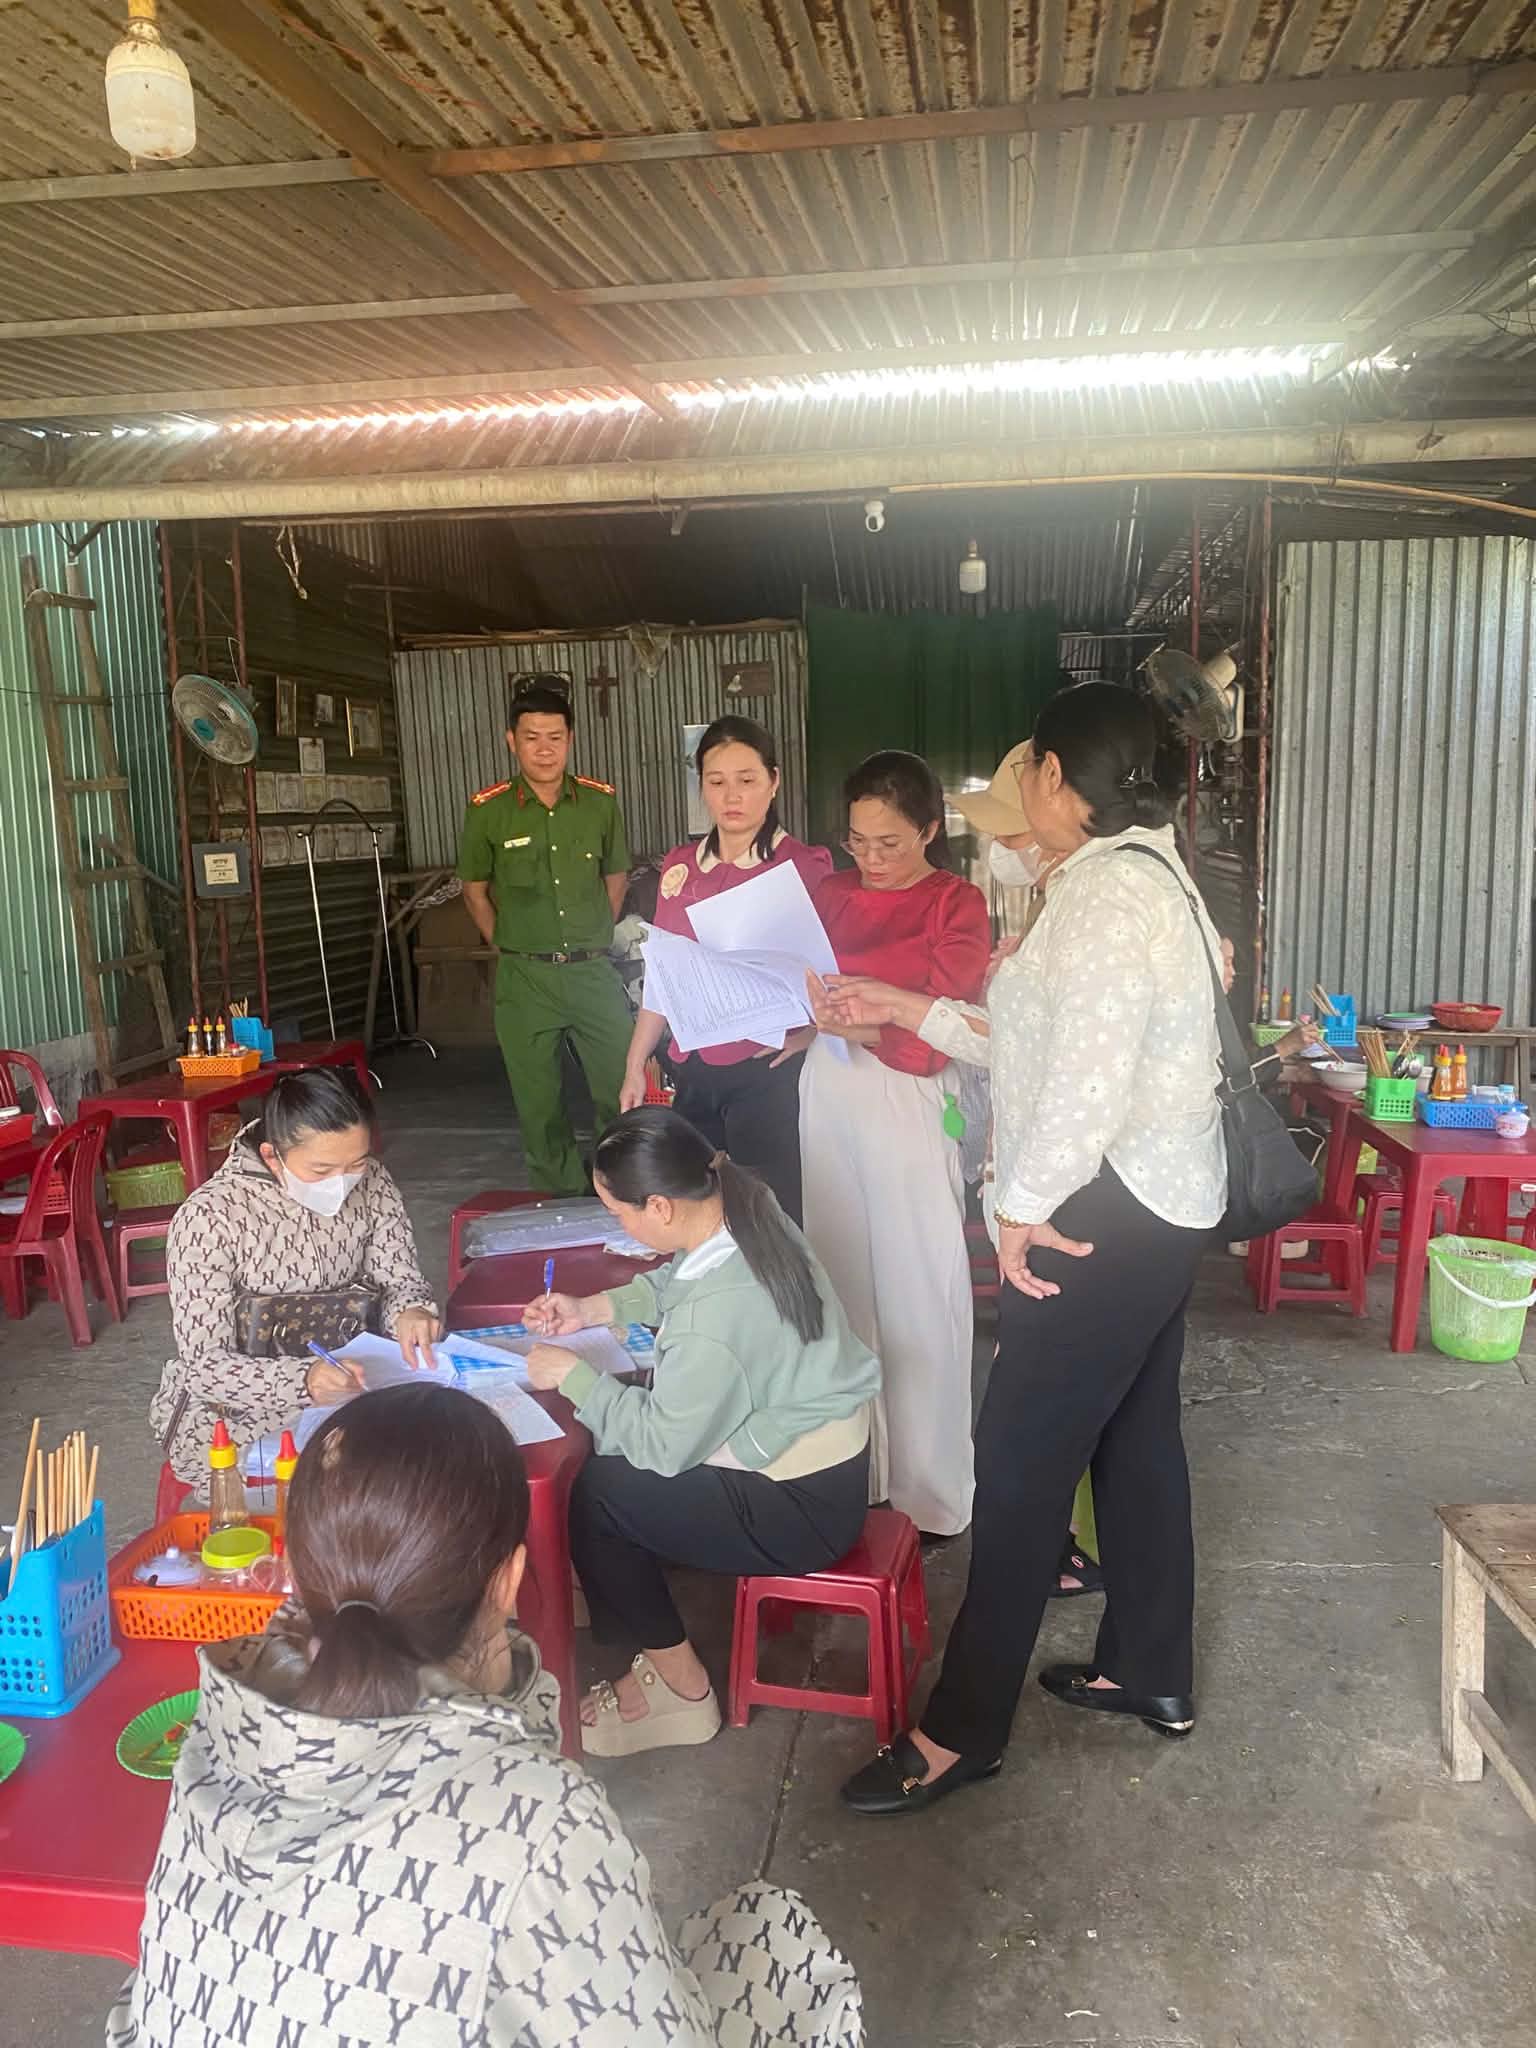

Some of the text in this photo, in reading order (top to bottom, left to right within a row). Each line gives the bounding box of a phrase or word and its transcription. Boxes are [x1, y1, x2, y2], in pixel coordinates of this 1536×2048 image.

[190, 1232, 203, 1246] N
[203, 1248, 212, 1262] Y
[274, 1251, 284, 1266] Y
[284, 1234, 294, 1249] N
[295, 1244, 304, 1258] Y
[203, 1273, 212, 1288] Y
[253, 1258, 262, 1272] Y
[263, 1270, 273, 1285] N
[287, 1262, 300, 1278] N
[302, 1272, 312, 1286] Y
[192, 1314, 203, 1329] N
[205, 1297, 215, 1310] Y
[206, 1323, 217, 1339] Y
[294, 1736, 336, 1764] N
[419, 1737, 462, 1765] Y
[489, 1756, 523, 1787] Y
[374, 1768, 418, 1802] N
[426, 1778, 475, 1820] N
[387, 1804, 421, 1851] Y
[495, 1793, 543, 1839] N
[585, 1806, 615, 1846] Y
[330, 1842, 374, 1888] N
[453, 1822, 490, 1867] Y
[174, 1870, 206, 1916] N
[390, 1856, 438, 1905] N
[536, 1850, 571, 1896] Y
[582, 1857, 618, 1914] N
[211, 1889, 245, 1938] N
[298, 1874, 327, 1920] Y
[352, 1890, 386, 1938] Y
[458, 1874, 506, 1925] N
[732, 1892, 764, 1914] N
[156, 1898, 171, 1944] Y
[189, 1918, 208, 1965] Y
[252, 1909, 288, 1958] N
[417, 1907, 453, 1956] Y
[527, 1909, 571, 1963] N
[575, 1919, 607, 1966] Y
[750, 1918, 771, 1954] Y
[782, 1904, 807, 1941] N
[227, 1939, 249, 1987] Y
[298, 1926, 339, 1976] N
[355, 1943, 403, 1995] N
[618, 1925, 650, 1981] N
[713, 1942, 746, 1975] N
[794, 1947, 816, 1985] Y
[158, 1950, 181, 2000] N
[267, 1960, 294, 2008] Y
[424, 1962, 472, 2015] N
[515, 1968, 551, 2011] Y
[764, 1957, 790, 2000] N
[806, 1982, 836, 2011] N
[189, 1972, 219, 2024] N
[224, 1994, 258, 2047] N
[320, 1978, 351, 2028] Y
[564, 1978, 607, 2031] N
[611, 1986, 643, 2031] Y
[652, 1989, 681, 2045] N
[731, 1979, 754, 2018] Y
[386, 1997, 419, 2046] Y
[776, 2009, 797, 2043] Y
